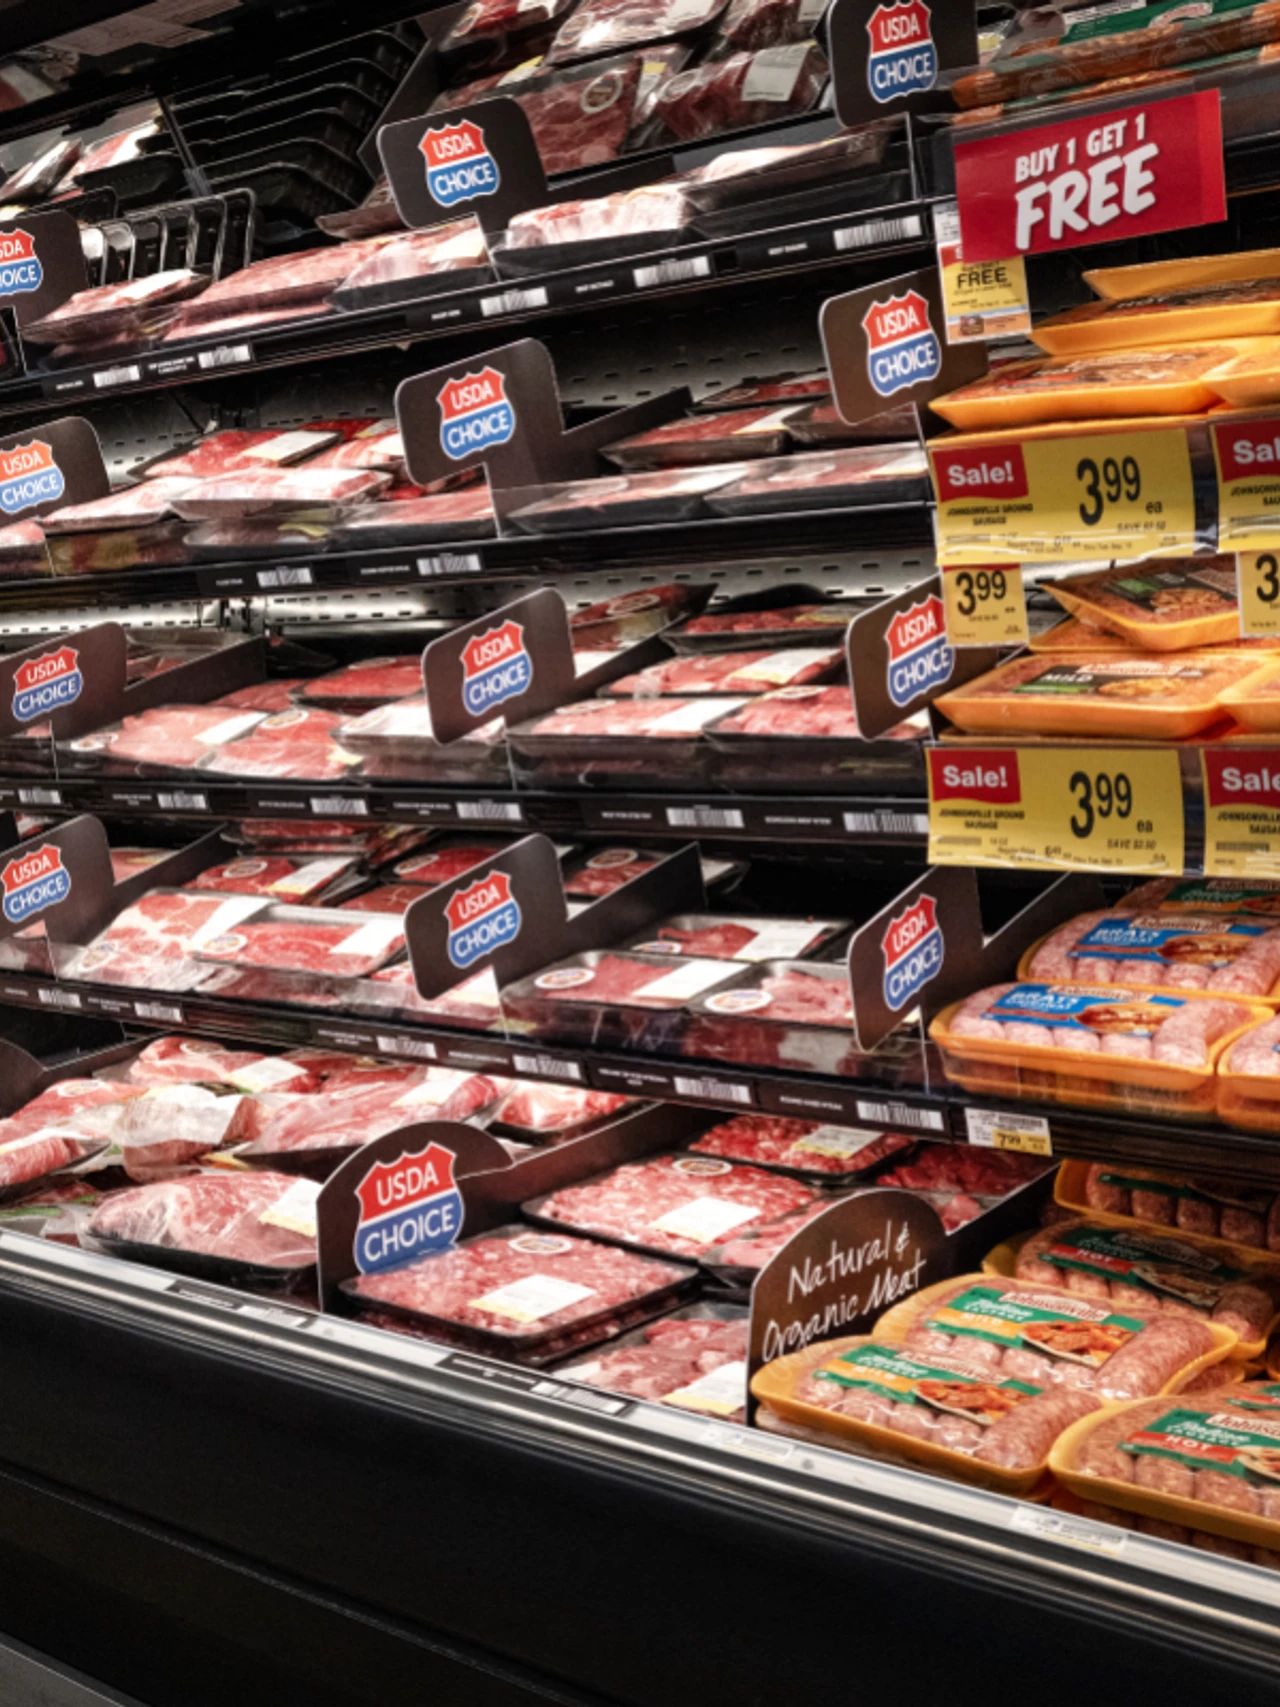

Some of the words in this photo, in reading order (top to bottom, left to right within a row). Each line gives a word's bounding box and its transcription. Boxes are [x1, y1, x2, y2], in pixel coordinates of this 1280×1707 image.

[880, 13, 921, 44] USDA
[874, 52, 933, 89] CHOICE
[432, 132, 475, 158] USDA
[1015, 144, 1059, 183] BUY
[1067, 137, 1076, 165] 1
[1086, 119, 1127, 157] GET
[1135, 112, 1145, 141] 1
[435, 162, 494, 195] CHOICE
[1014, 142, 1159, 250] FREE
[957, 267, 1008, 289] FREE
[876, 305, 920, 339] USDA
[875, 342, 936, 383] CHOICE
[450, 380, 495, 410] USDA
[448, 409, 510, 448] CHOICE
[2, 451, 44, 476] USDA
[948, 461, 1014, 486] Sale!
[1, 475, 60, 506] CHOICE
[1146, 501, 1163, 515] ea
[897, 610, 937, 648] USDA
[472, 634, 515, 667] USDA
[26, 656, 67, 684] USDA
[469, 660, 526, 705] CHOICE
[893, 646, 950, 694] CHOICE
[18, 676, 78, 713] CHOICE
[943, 764, 1008, 788] Sale!
[1137, 820, 1153, 833] ea
[12, 857, 52, 883] USDA
[10, 879, 66, 914] CHOICE
[457, 884, 500, 919] USDA
[455, 909, 516, 958] CHOICE
[892, 910, 928, 952] USDA
[890, 939, 940, 998] CHOICE
[376, 1161, 438, 1206] USDA
[364, 1203, 455, 1262] CHOICE
[788, 1220, 892, 1304] Natural
[895, 1222, 910, 1261] &
[762, 1295, 859, 1362] Organic
[862, 1249, 927, 1315] Meat
[1166, 1435, 1211, 1450] HOT
